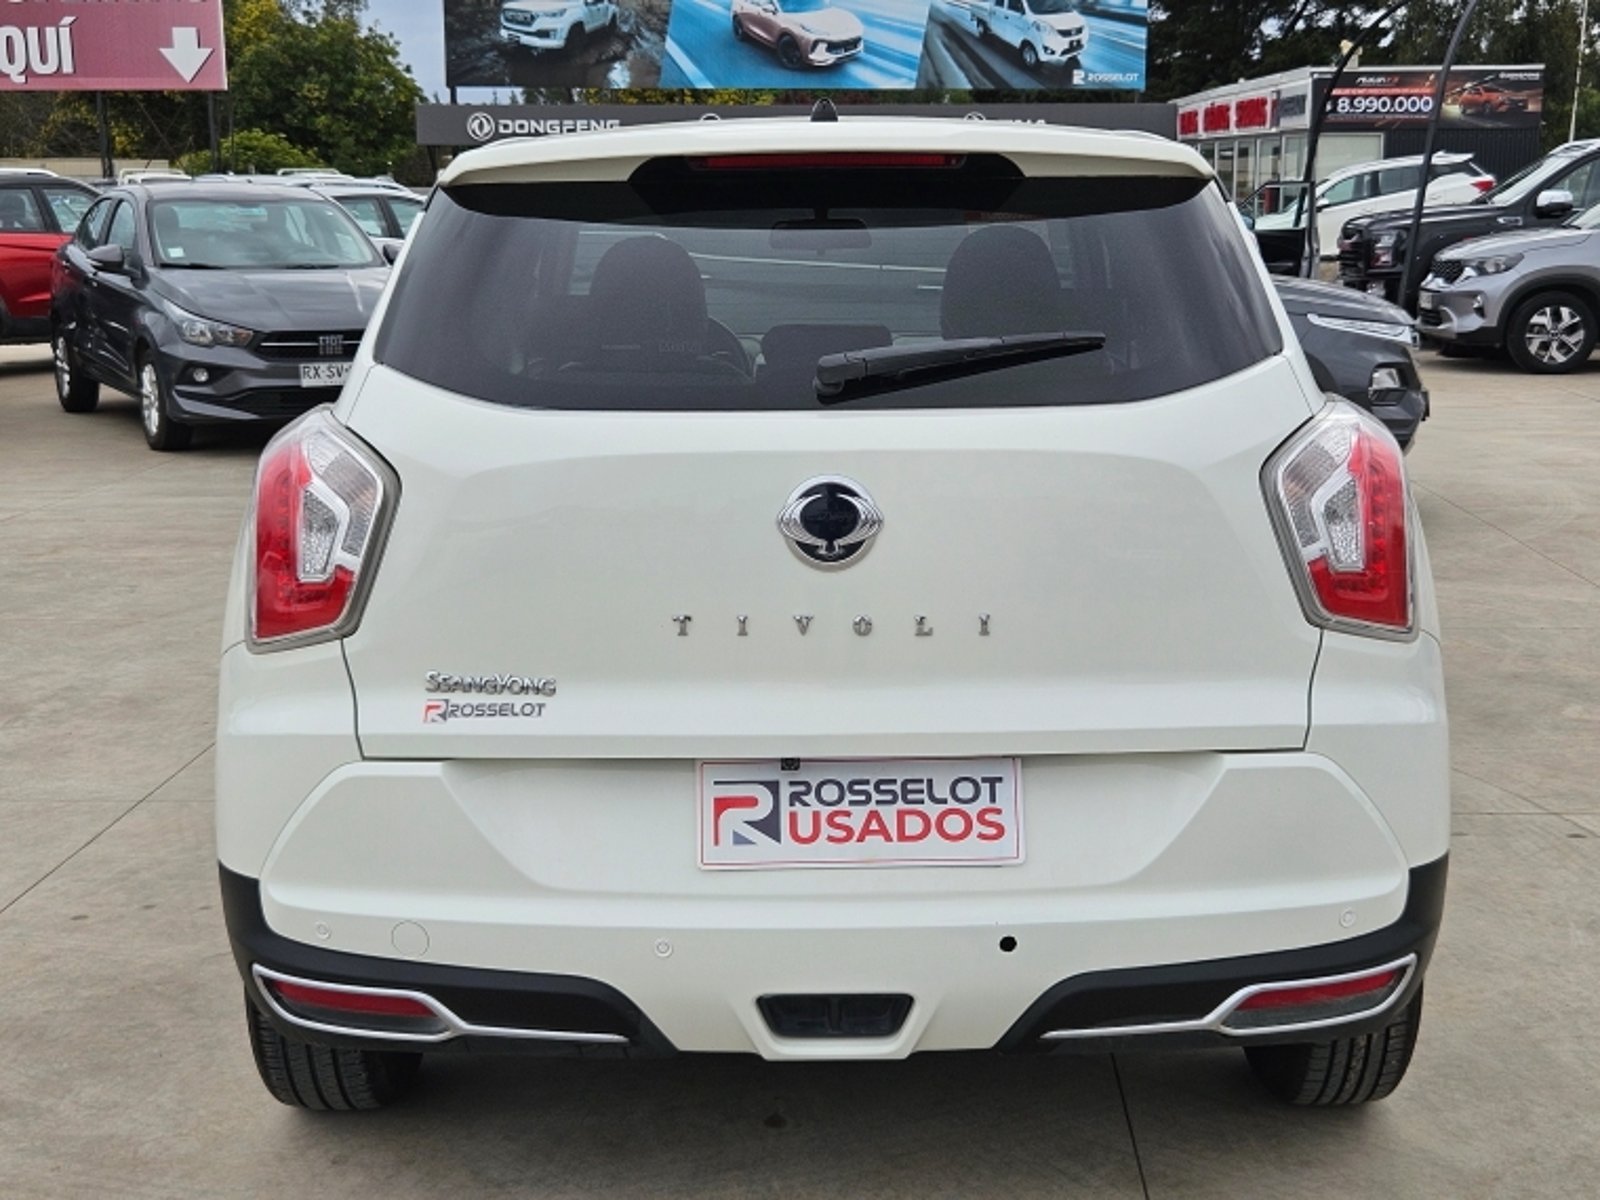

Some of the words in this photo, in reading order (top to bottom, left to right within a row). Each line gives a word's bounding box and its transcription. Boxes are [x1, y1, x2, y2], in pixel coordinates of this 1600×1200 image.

[1088, 72, 1139, 83] ROSSELOT
[1337, 96, 1433, 113] 8.990.000
[498, 119, 620, 134] DONGFENG
[672, 614, 991, 637] TIVOLI
[448, 702, 546, 719] ROSSELOT
[788, 776, 1003, 807] ROSSELOT
[788, 807, 1006, 845] USADOS
